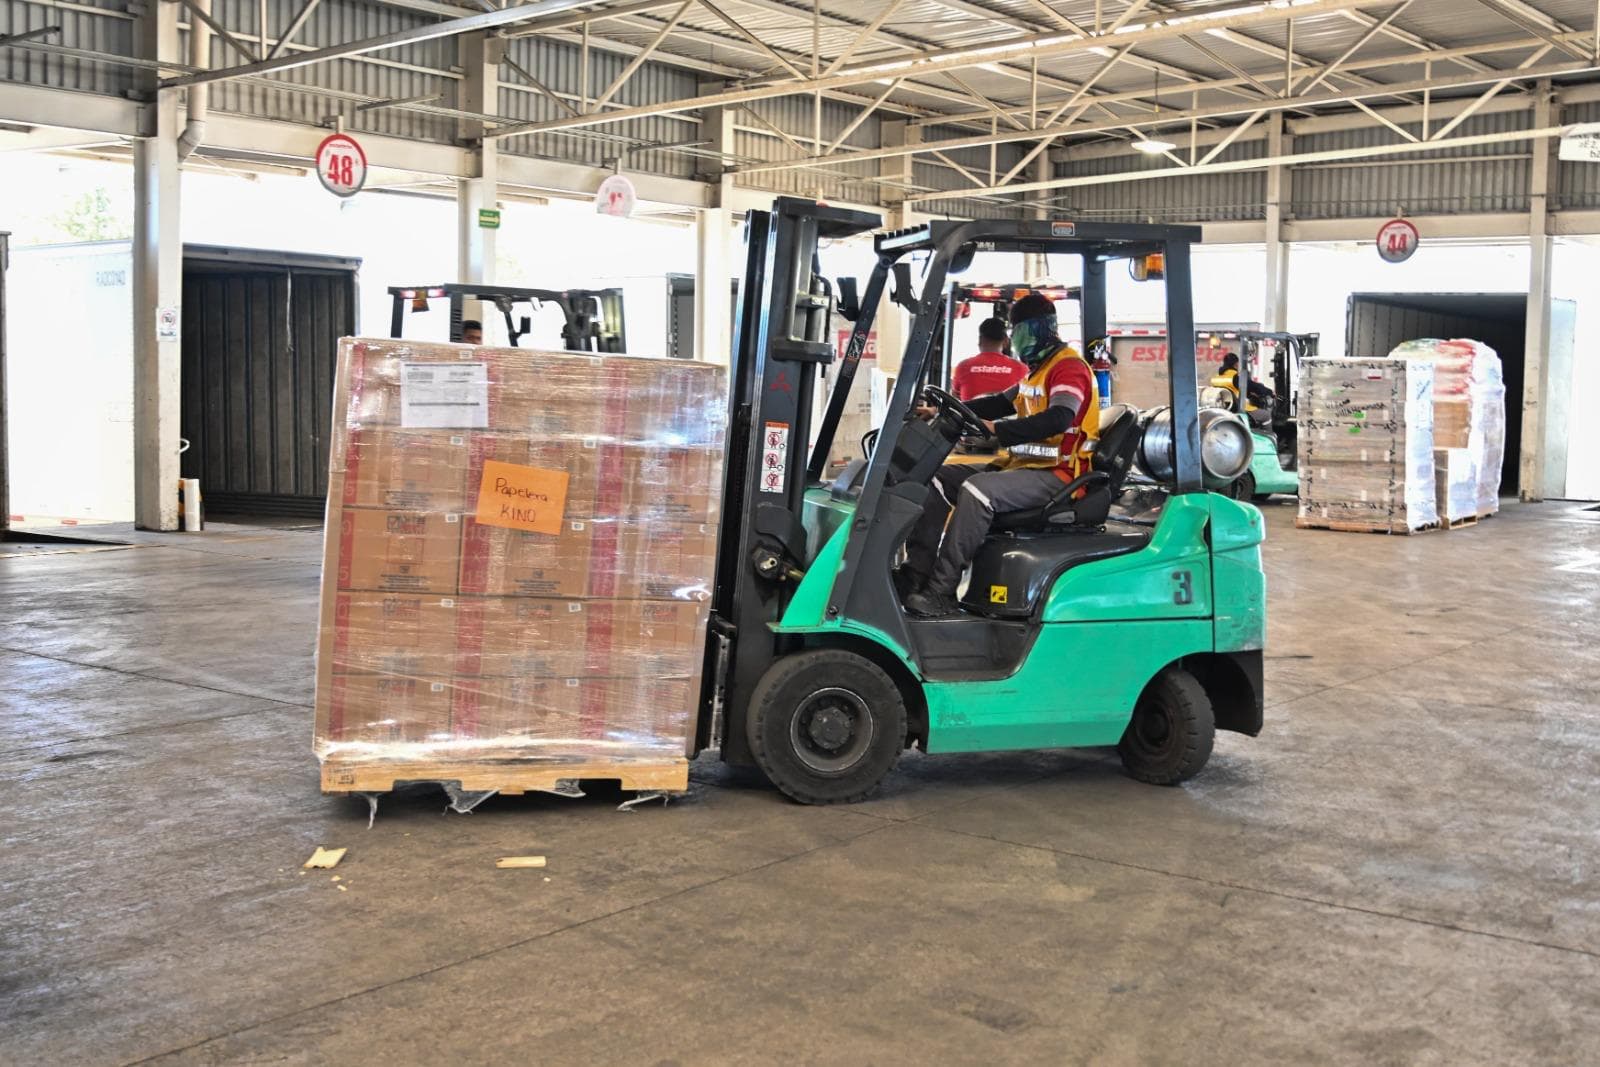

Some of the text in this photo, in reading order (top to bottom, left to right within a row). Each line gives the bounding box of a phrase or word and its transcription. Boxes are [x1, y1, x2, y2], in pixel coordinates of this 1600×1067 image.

[327, 154, 353, 186] 48
[1387, 233, 1408, 255] 44
[1131, 343, 1228, 363] esteta
[970, 365, 1012, 374] estafeta
[495, 477, 548, 502] Papelera
[500, 503, 537, 523] KINO
[1171, 570, 1193, 606] 3
